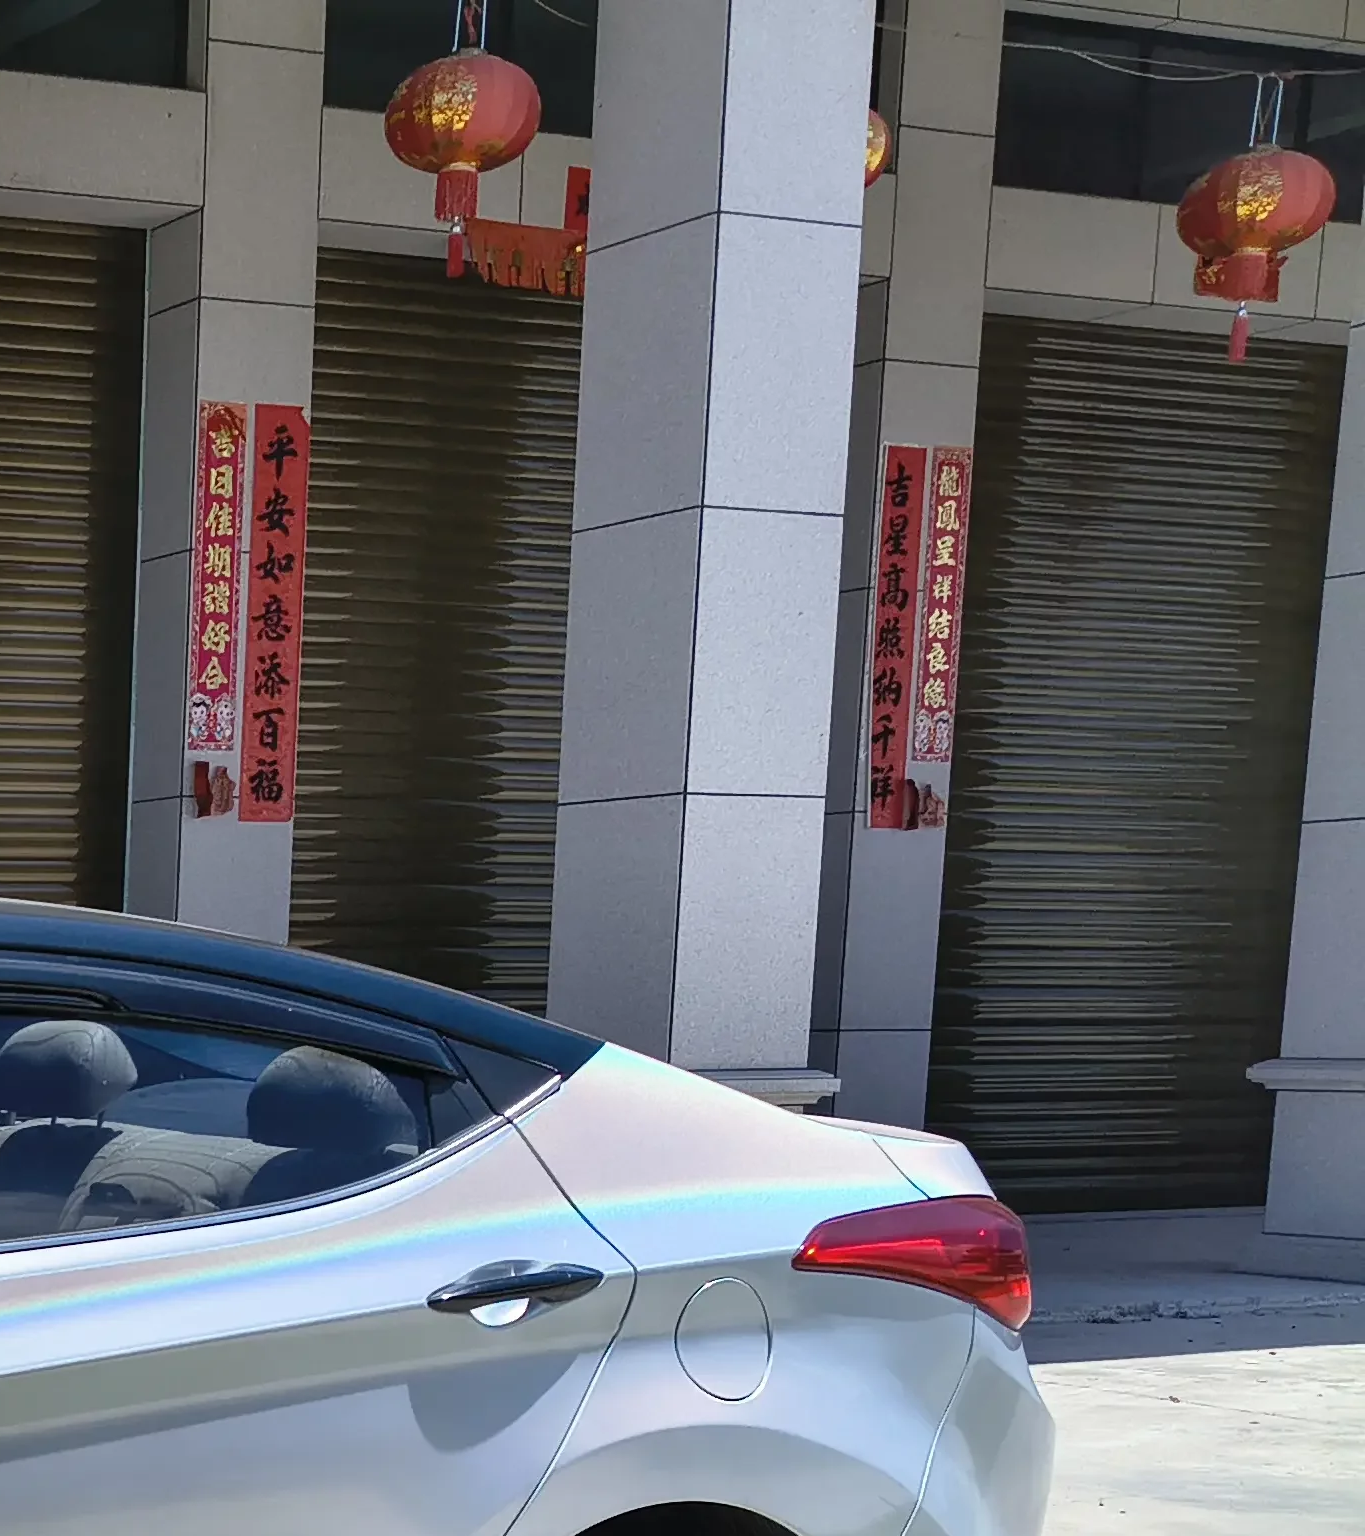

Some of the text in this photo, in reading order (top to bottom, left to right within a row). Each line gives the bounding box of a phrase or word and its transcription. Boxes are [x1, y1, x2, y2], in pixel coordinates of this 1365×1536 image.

[248, 423, 299, 804] 平安如意添百福
